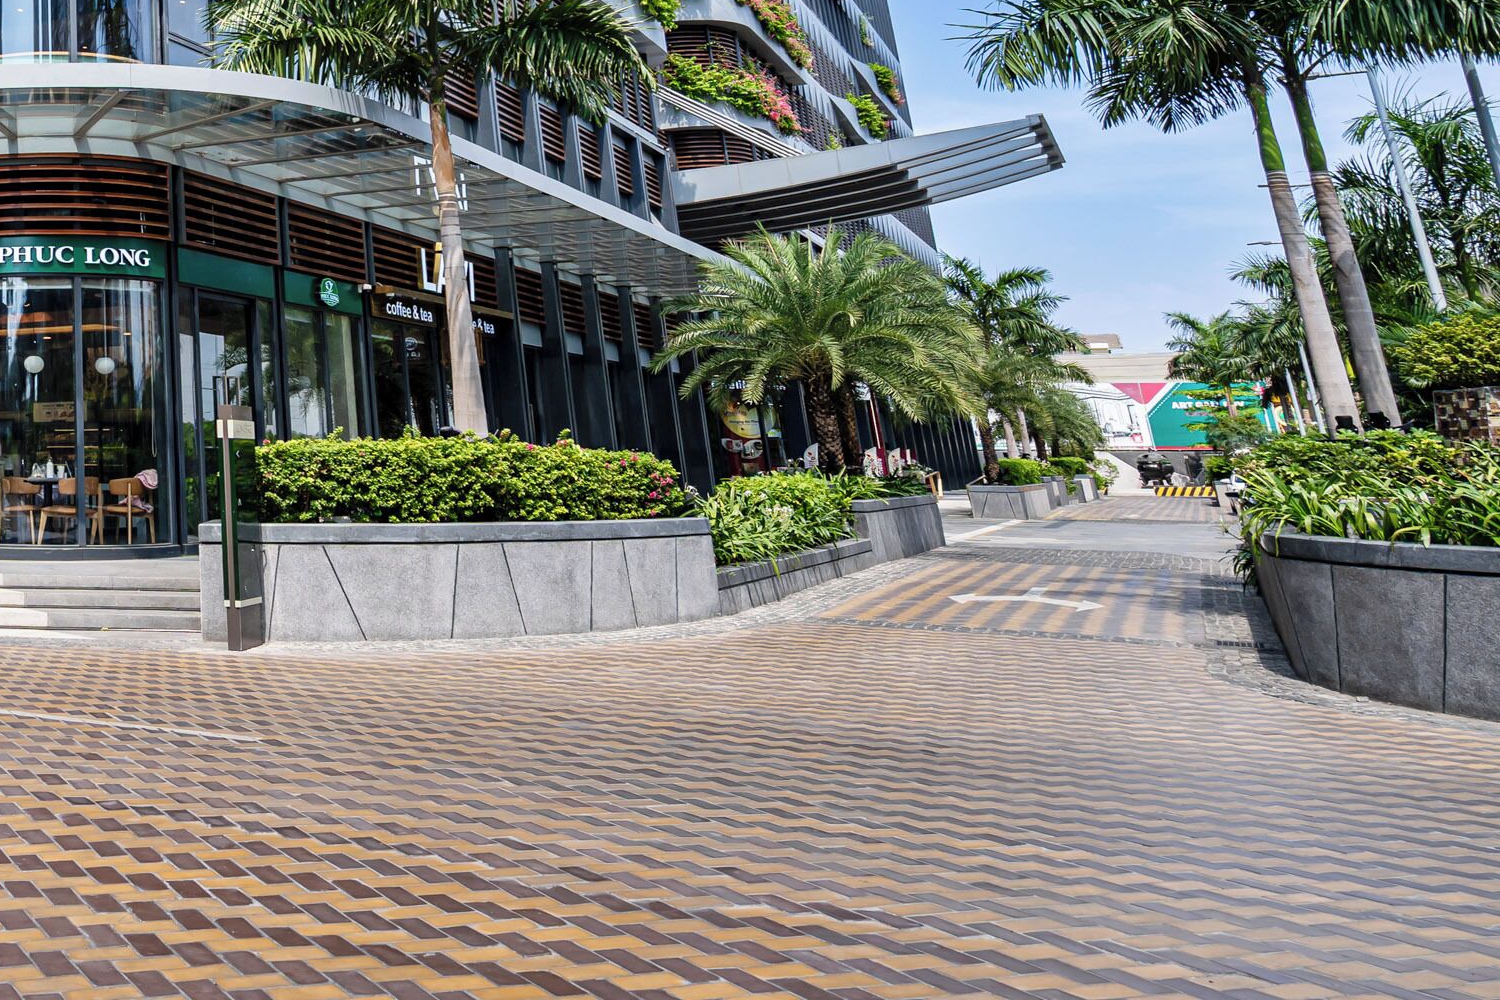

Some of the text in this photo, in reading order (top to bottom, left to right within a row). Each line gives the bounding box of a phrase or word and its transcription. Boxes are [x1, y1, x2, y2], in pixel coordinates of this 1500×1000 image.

[84, 247, 151, 267] LONG
[386, 301, 433, 323] coffee & tea
[484, 321, 496, 335] tea
[1172, 401, 1194, 409] ART
